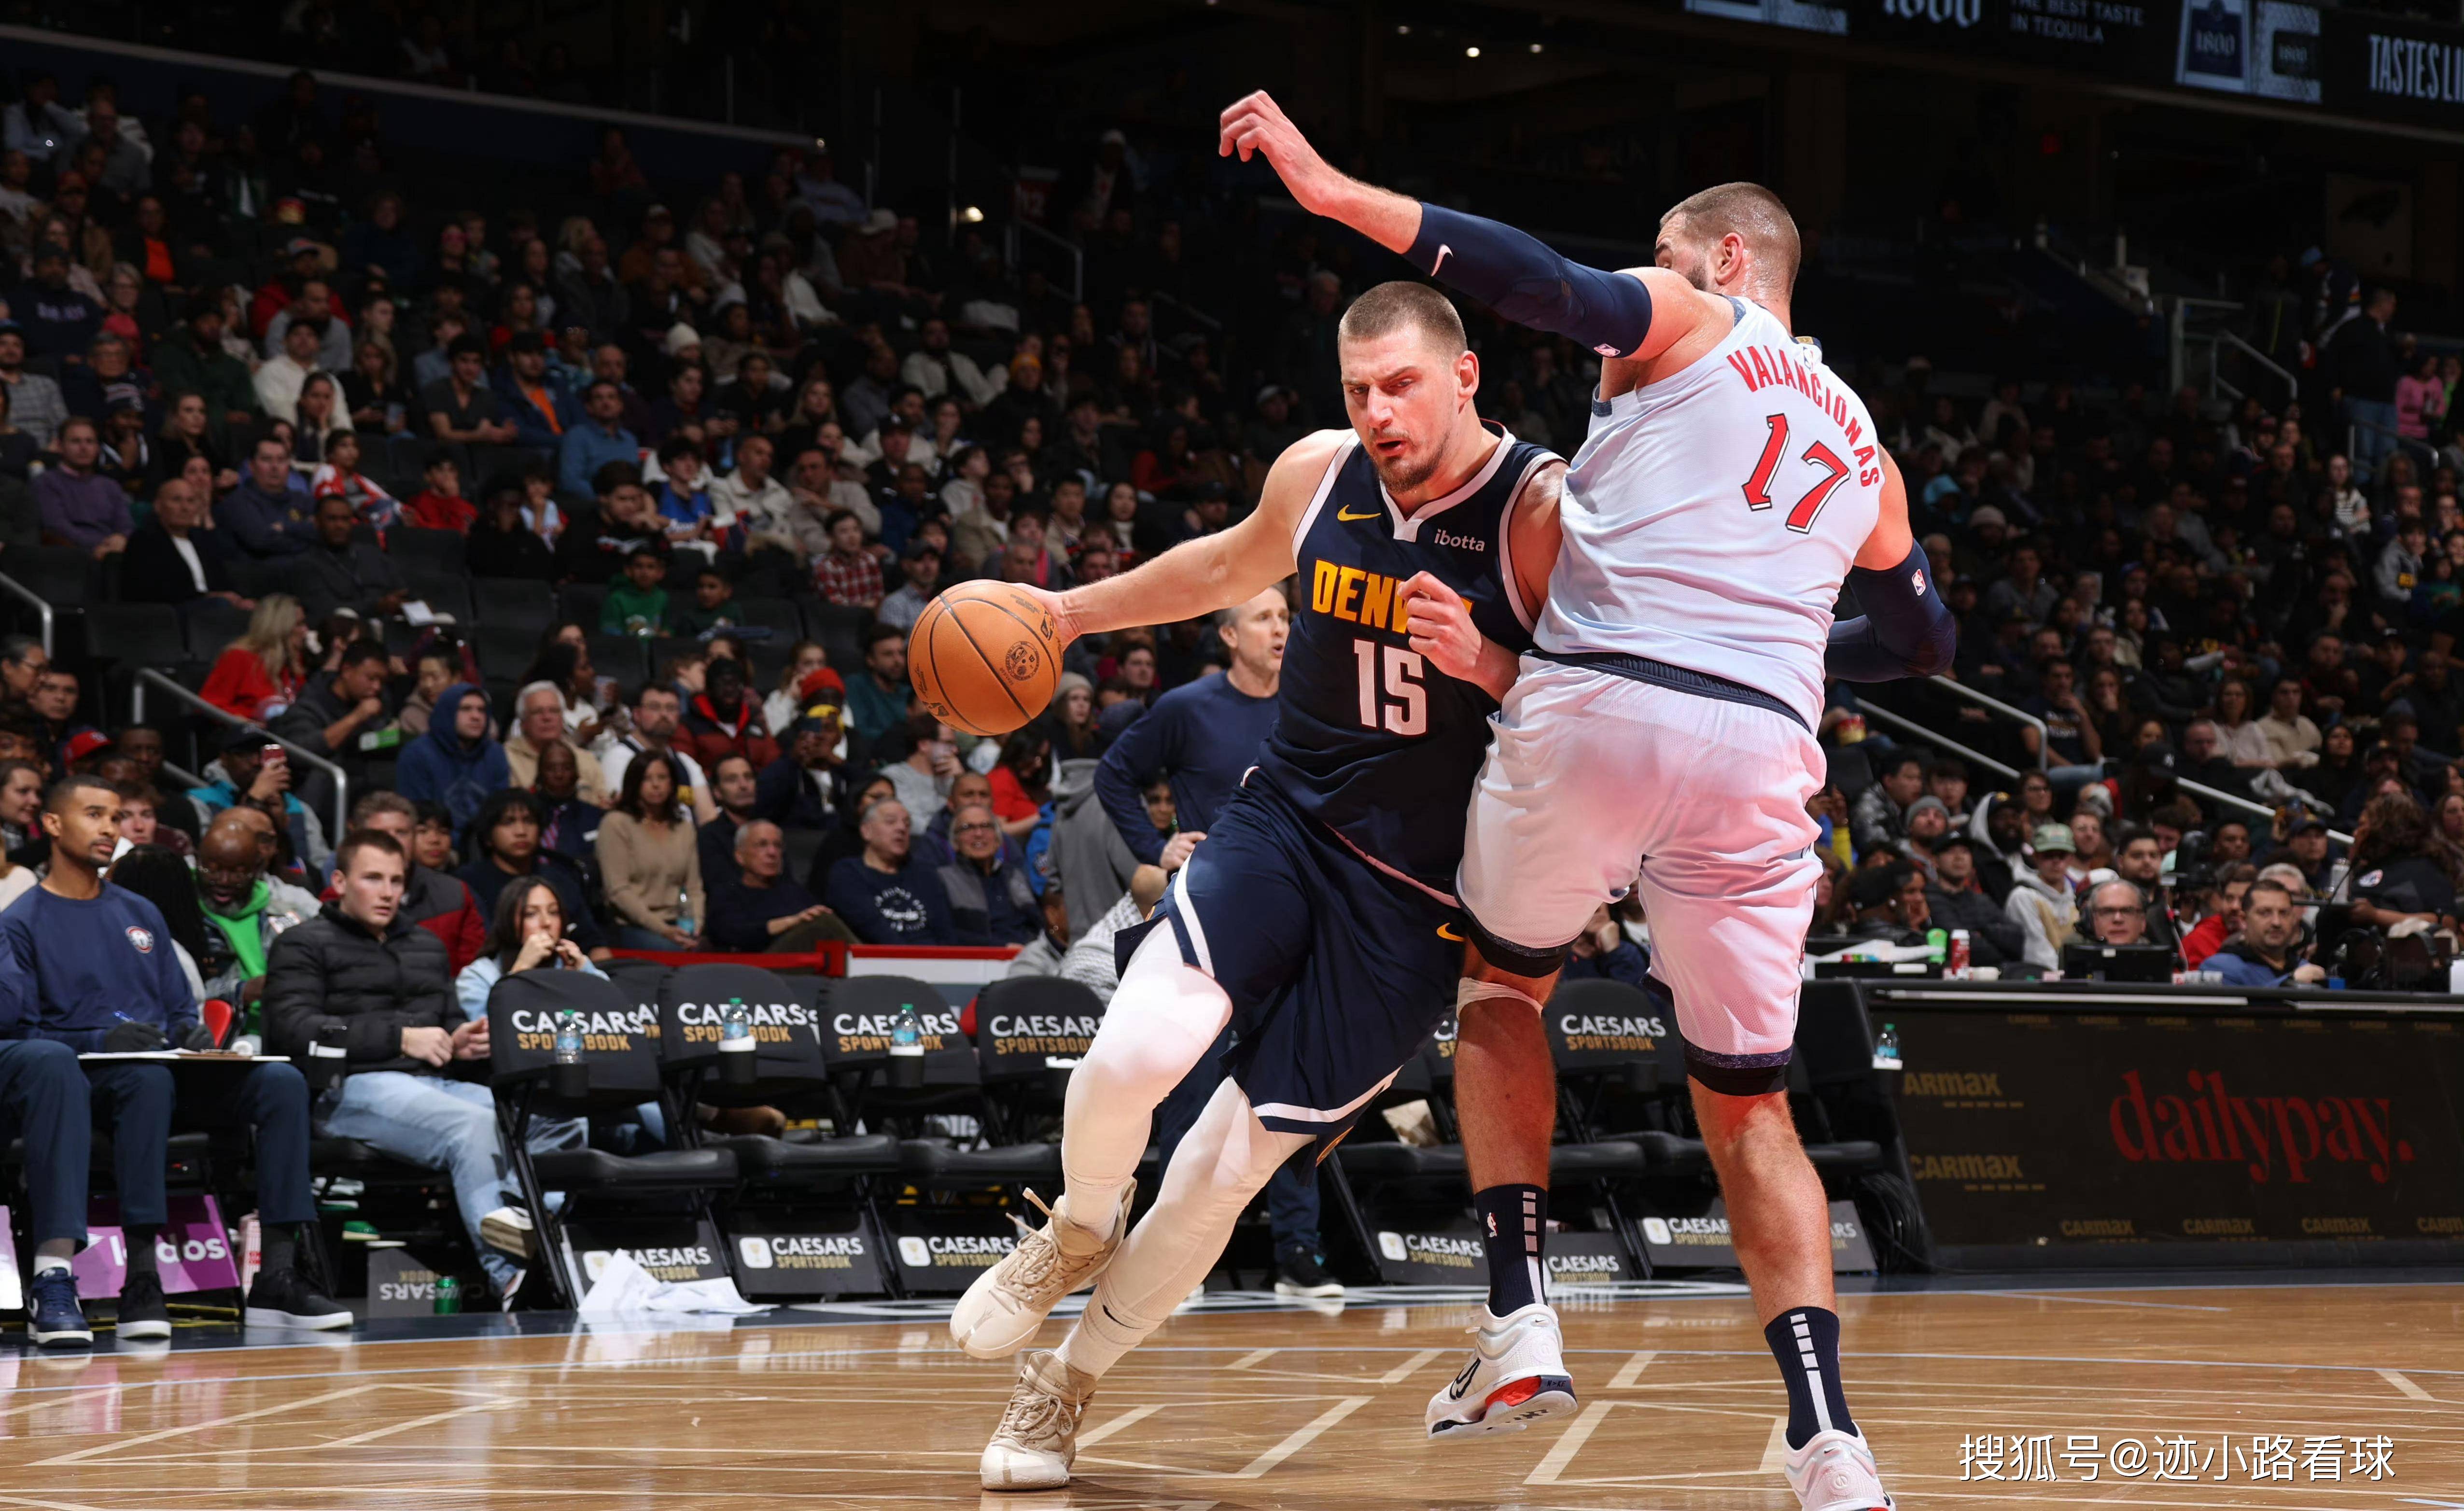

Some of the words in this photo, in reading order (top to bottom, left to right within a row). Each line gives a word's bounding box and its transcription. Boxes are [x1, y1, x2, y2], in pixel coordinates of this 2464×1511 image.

[2092, 1, 2145, 27] TASTE
[2009, 13, 2029, 31] IN
[2031, 16, 2104, 44] TEQUILA
[2368, 33, 2440, 100] TASTES
[2442, 44, 2464, 103] LI
[1741, 413, 1851, 534] 17
[1434, 529, 1485, 552] ibotta
[1312, 558, 1473, 634] DENV
[1354, 639, 1428, 736] 15
[1560, 1014, 1666, 1037] CAESARS
[517, 1033, 631, 1050] SPOBOOK
[839, 1035, 944, 1052] SPORTOK
[994, 1037, 1093, 1055] SPORTSBOO
[1566, 1035, 1655, 1051] SPORTSBOOK
[2110, 1069, 2412, 1183] dailypay.
[1668, 1217, 1731, 1234] CAESAR
[771, 1237, 864, 1255] CAESARS
[928, 1236, 1015, 1254] CAESARS
[1406, 1234, 1484, 1258] CAESARS
[1674, 1233, 1731, 1245] SPORTSBOO
[776, 1255, 853, 1269] SPORTSBOOK
[1410, 1251, 1474, 1268] SPORTSBOOK
[1548, 1256, 1620, 1272] CAESARS
